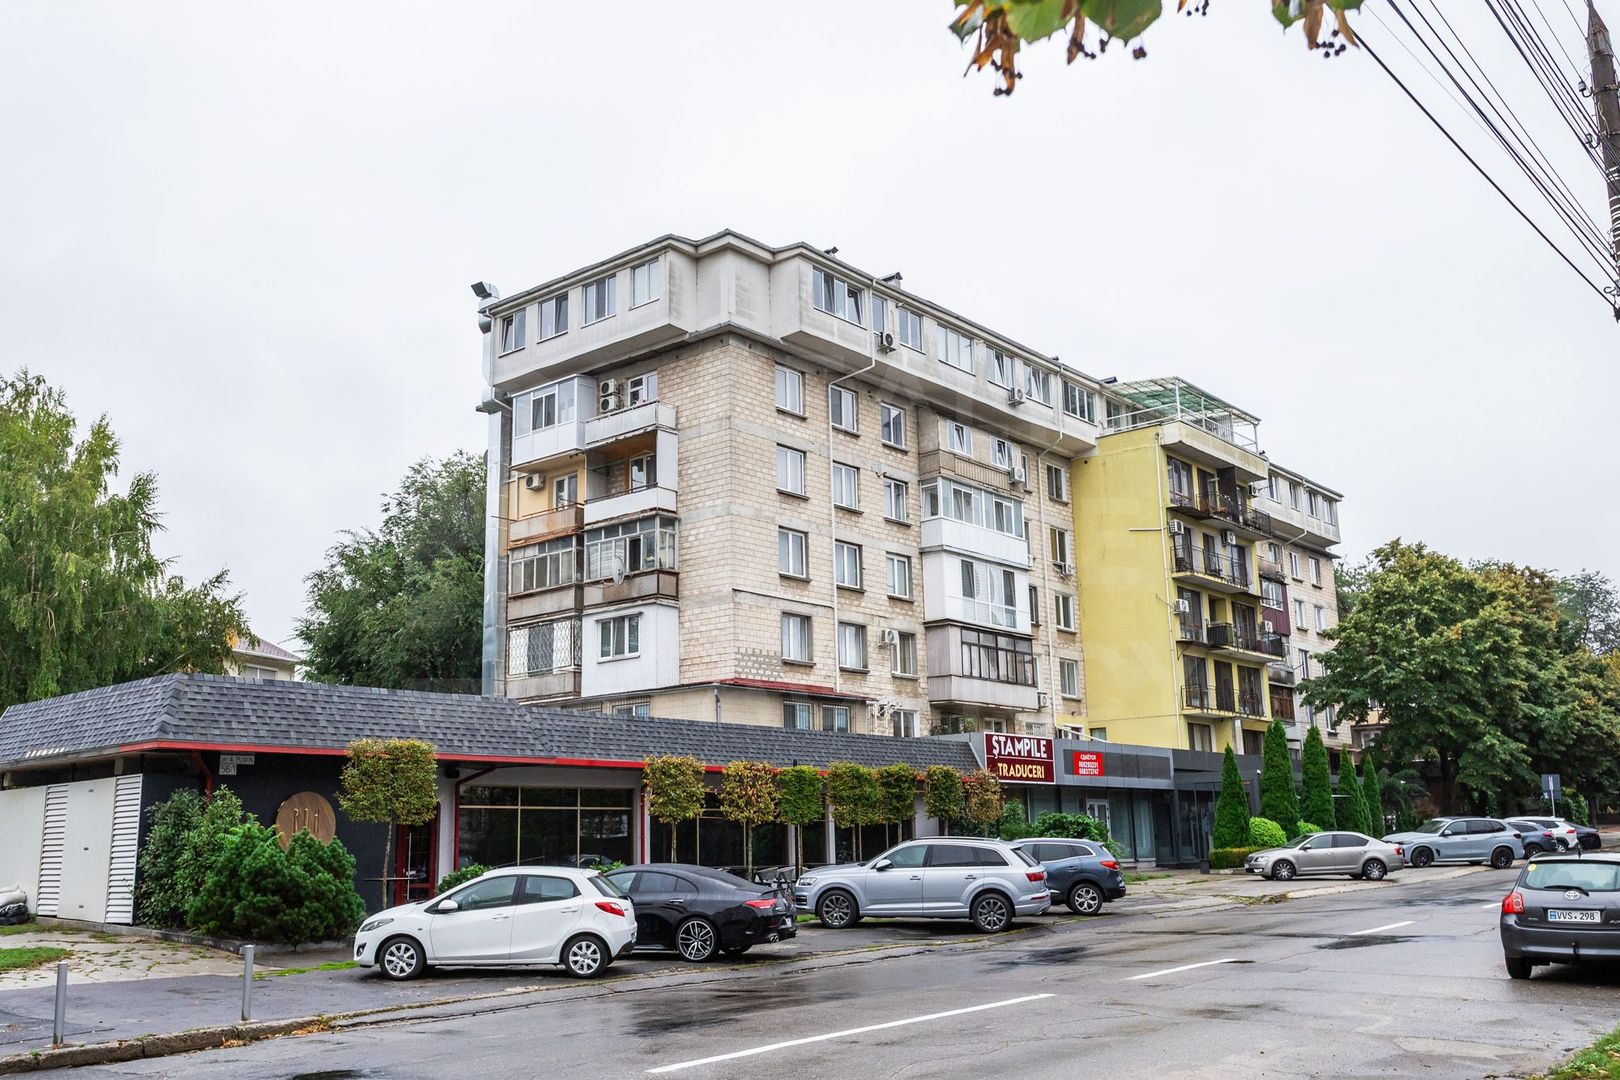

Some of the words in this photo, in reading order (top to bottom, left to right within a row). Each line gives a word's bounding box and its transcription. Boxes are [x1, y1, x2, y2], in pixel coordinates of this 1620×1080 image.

[998, 763, 1045, 778] TRADUCERI
[1557, 911, 1573, 920] VVS
[1580, 912, 1595, 921] 298
